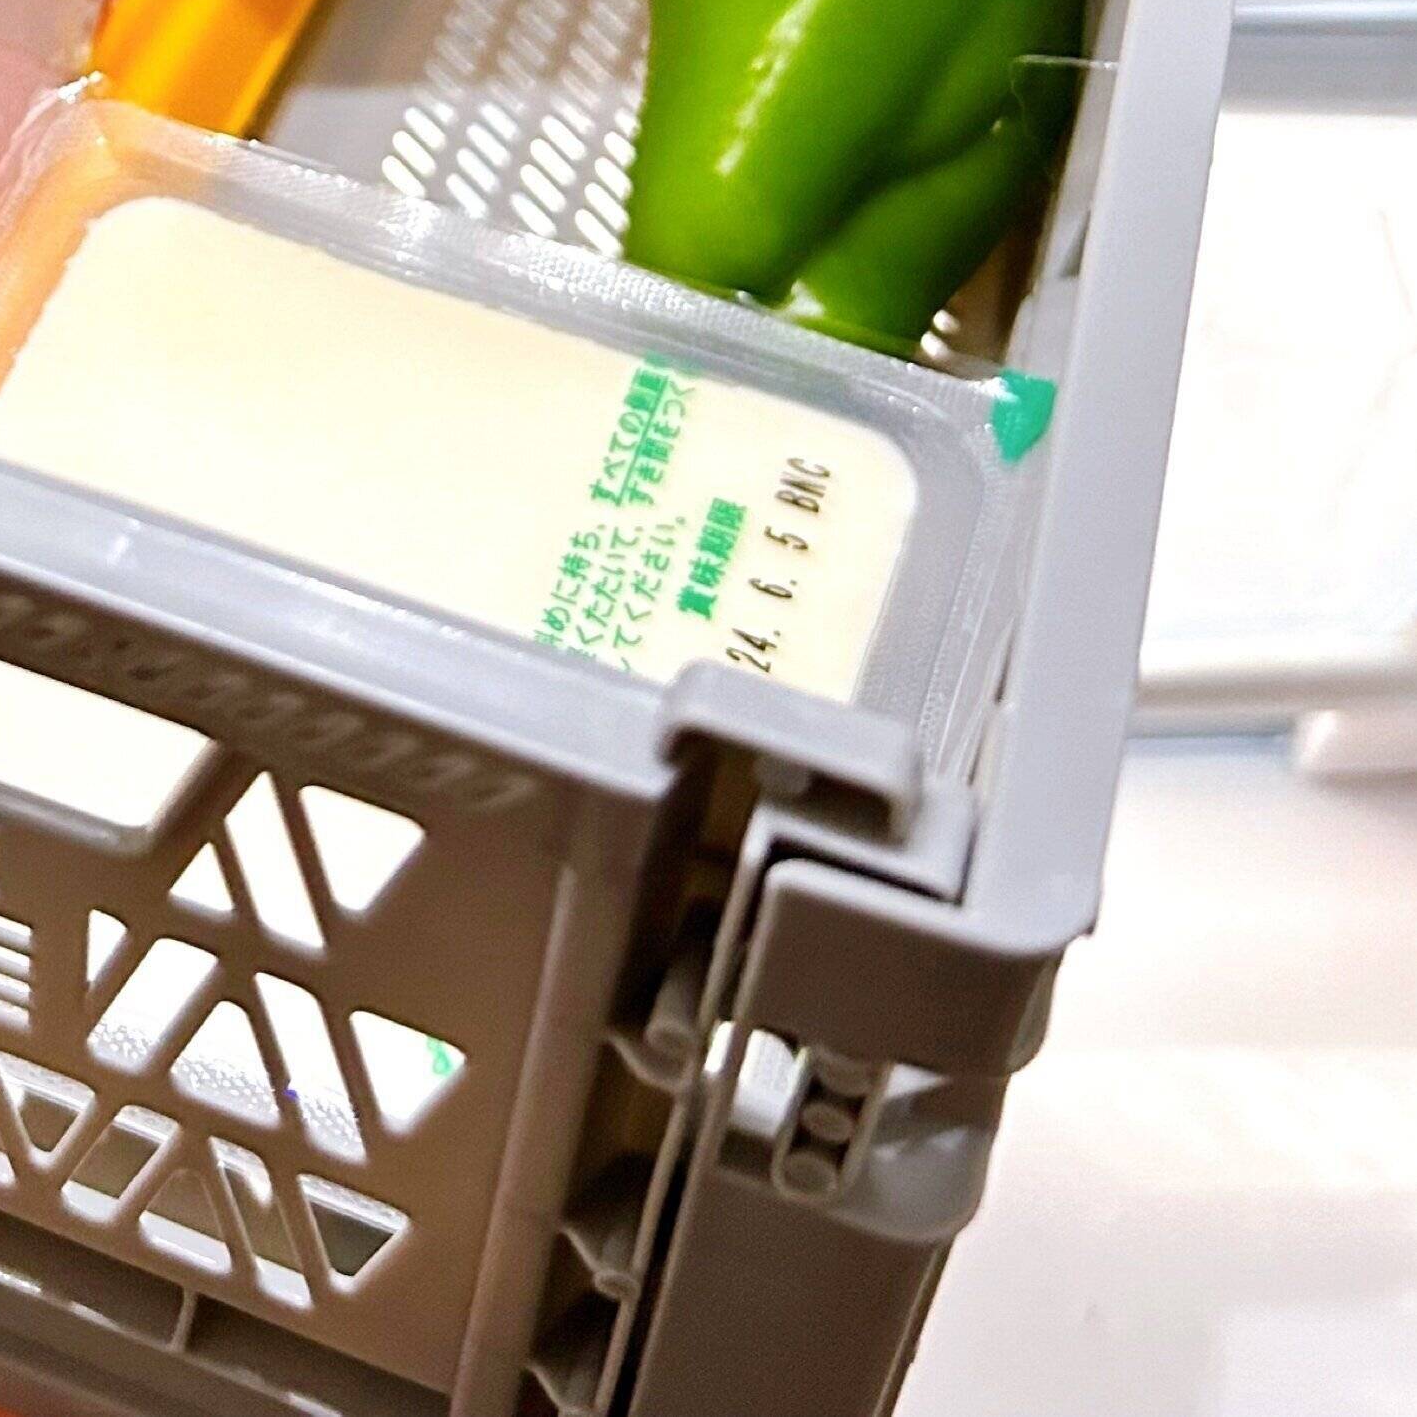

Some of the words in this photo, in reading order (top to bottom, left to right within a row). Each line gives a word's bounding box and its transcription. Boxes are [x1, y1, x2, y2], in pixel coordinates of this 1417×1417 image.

[763, 526, 808, 550] 5
[675, 497, 747, 620] 賞味期限
[747, 577, 798, 600] 6.
[725, 628, 781, 673] 24.
